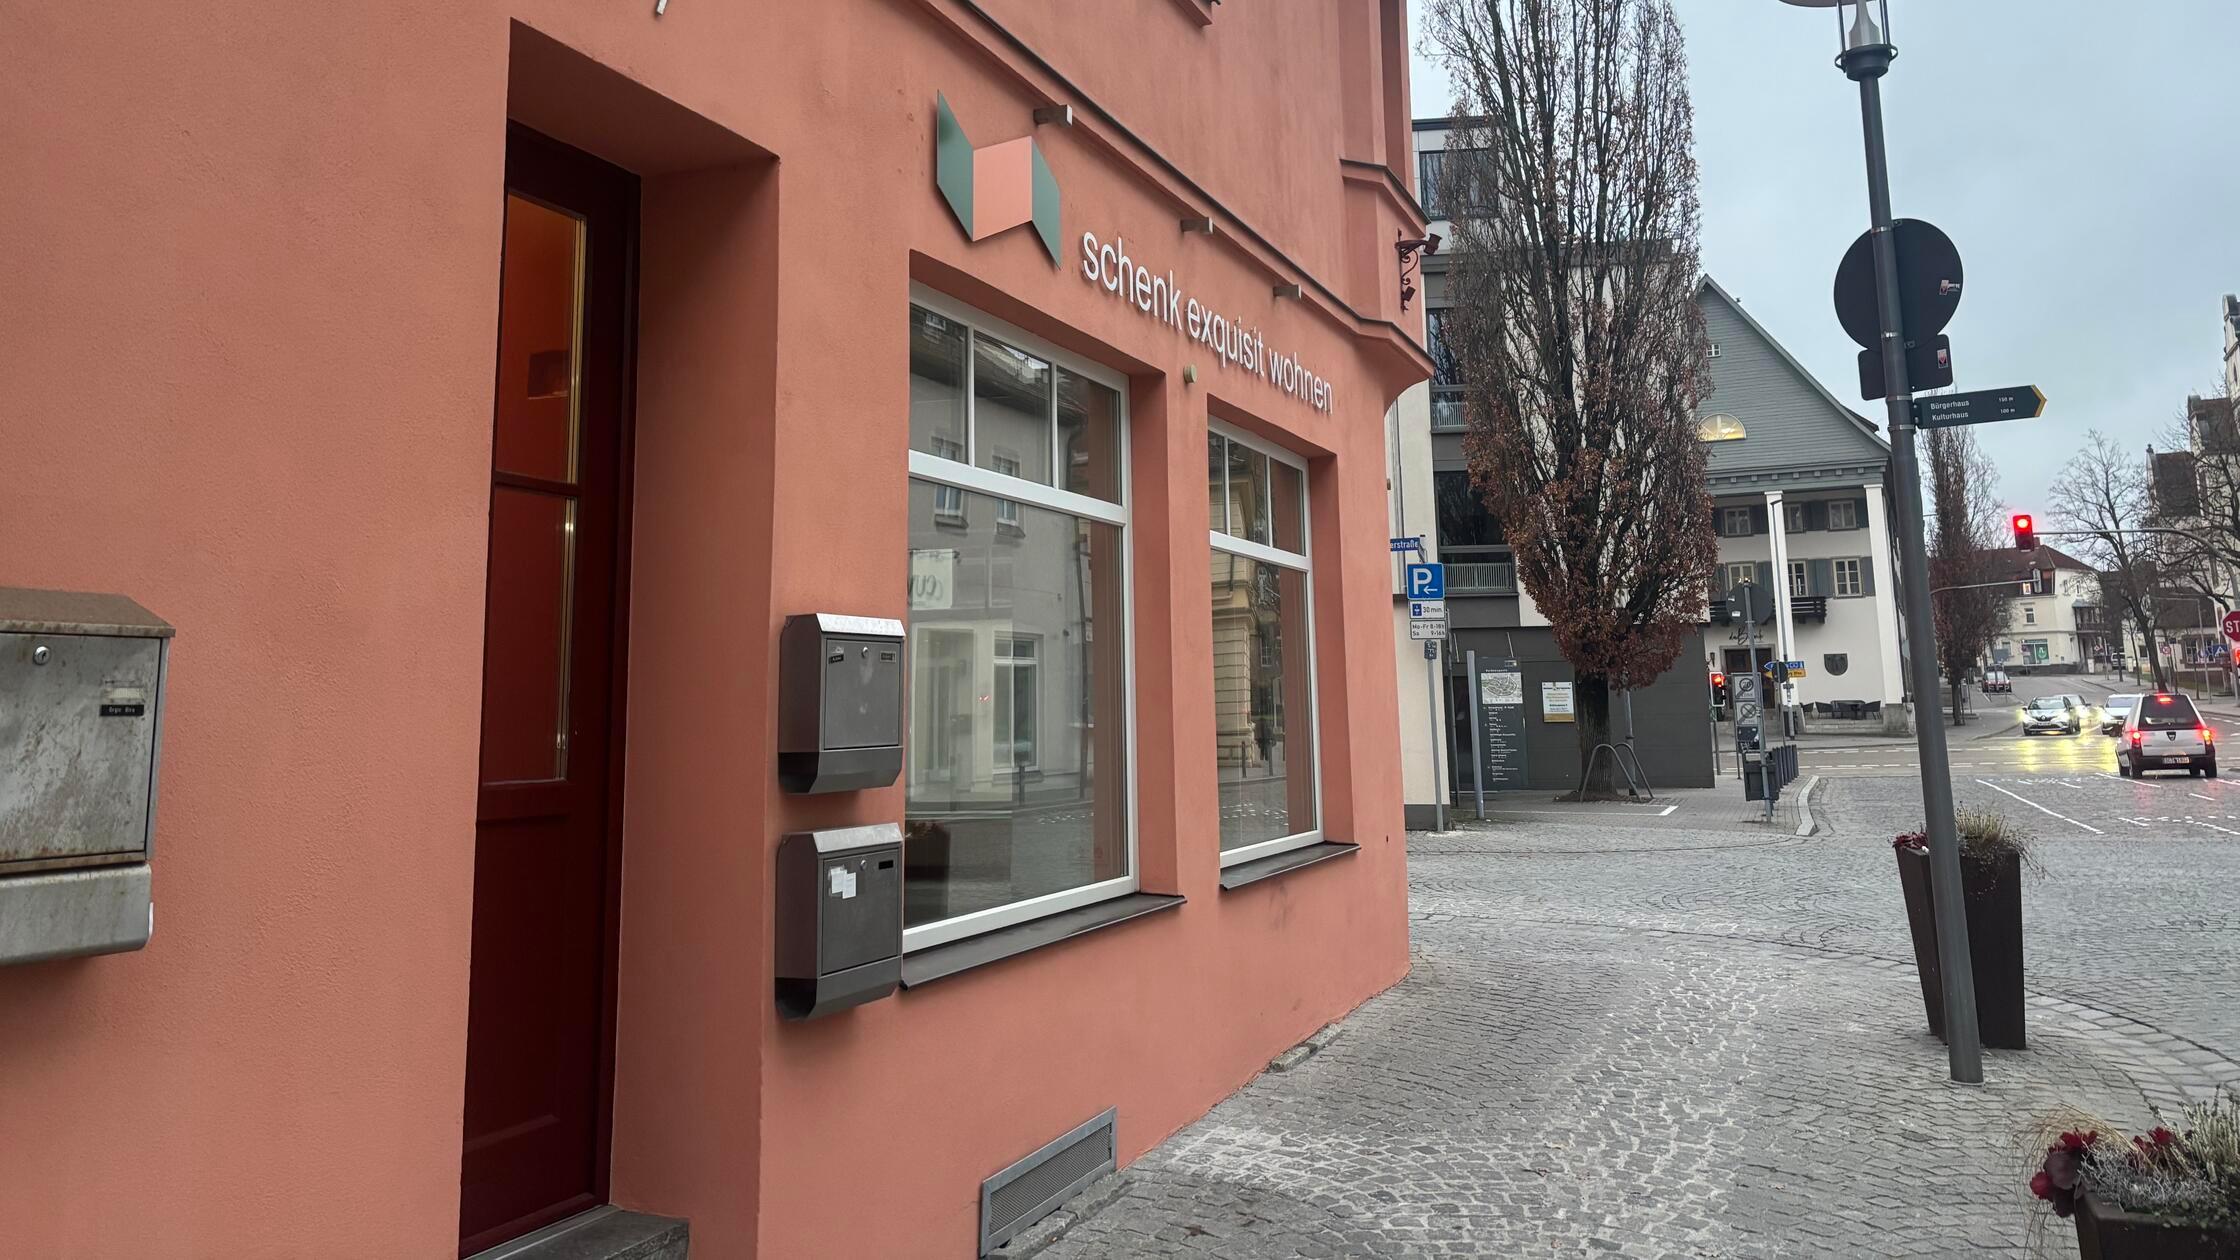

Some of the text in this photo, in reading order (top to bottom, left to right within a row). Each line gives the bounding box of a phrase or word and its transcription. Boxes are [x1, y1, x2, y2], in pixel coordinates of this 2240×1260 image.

[1082, 231, 1333, 415] schenk exquisit wohnen
[1930, 400, 1970, 410] Bürgerhaus
[1932, 413, 1969, 421] Kulturhaus
[1413, 568, 1433, 595] P
[2225, 620, 2240, 633] ST
